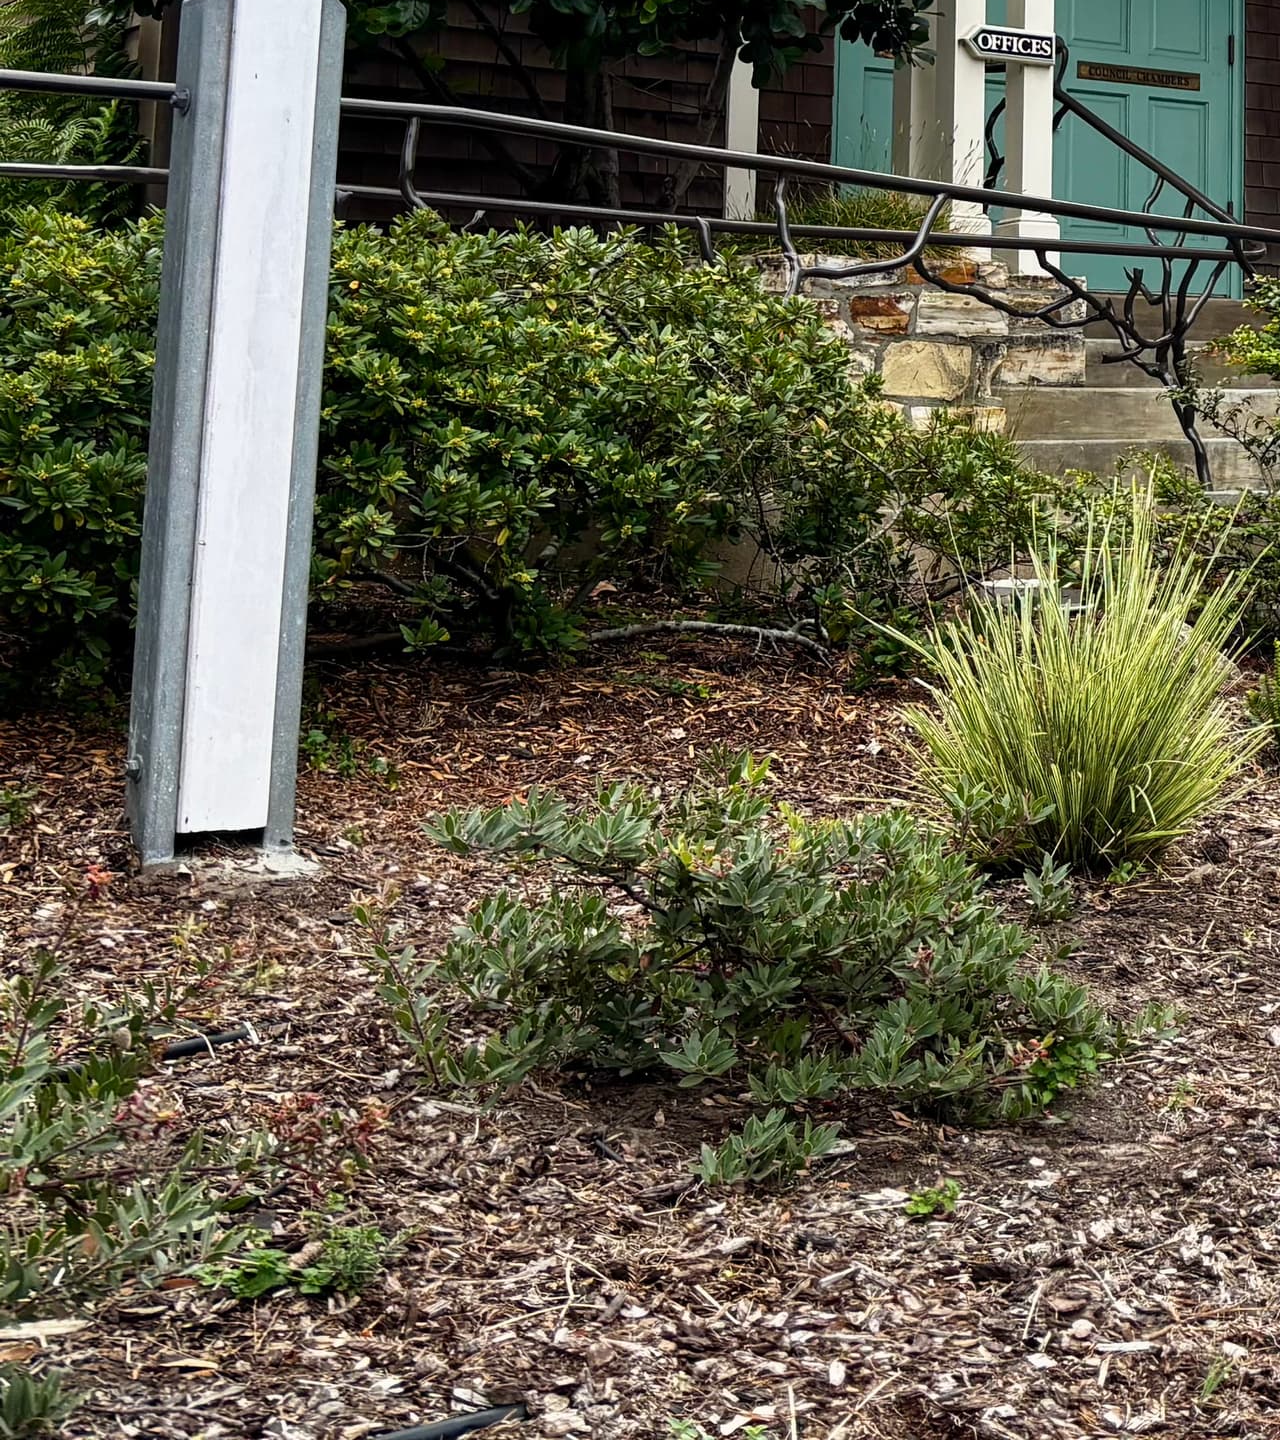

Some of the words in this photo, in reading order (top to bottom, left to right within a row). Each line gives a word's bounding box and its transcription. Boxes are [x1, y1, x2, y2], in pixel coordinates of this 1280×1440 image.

[977, 32, 1051, 56] OFFICES
[1088, 64, 1132, 81] COUNCIL
[1136, 70, 1190, 87] CHAMBERS
